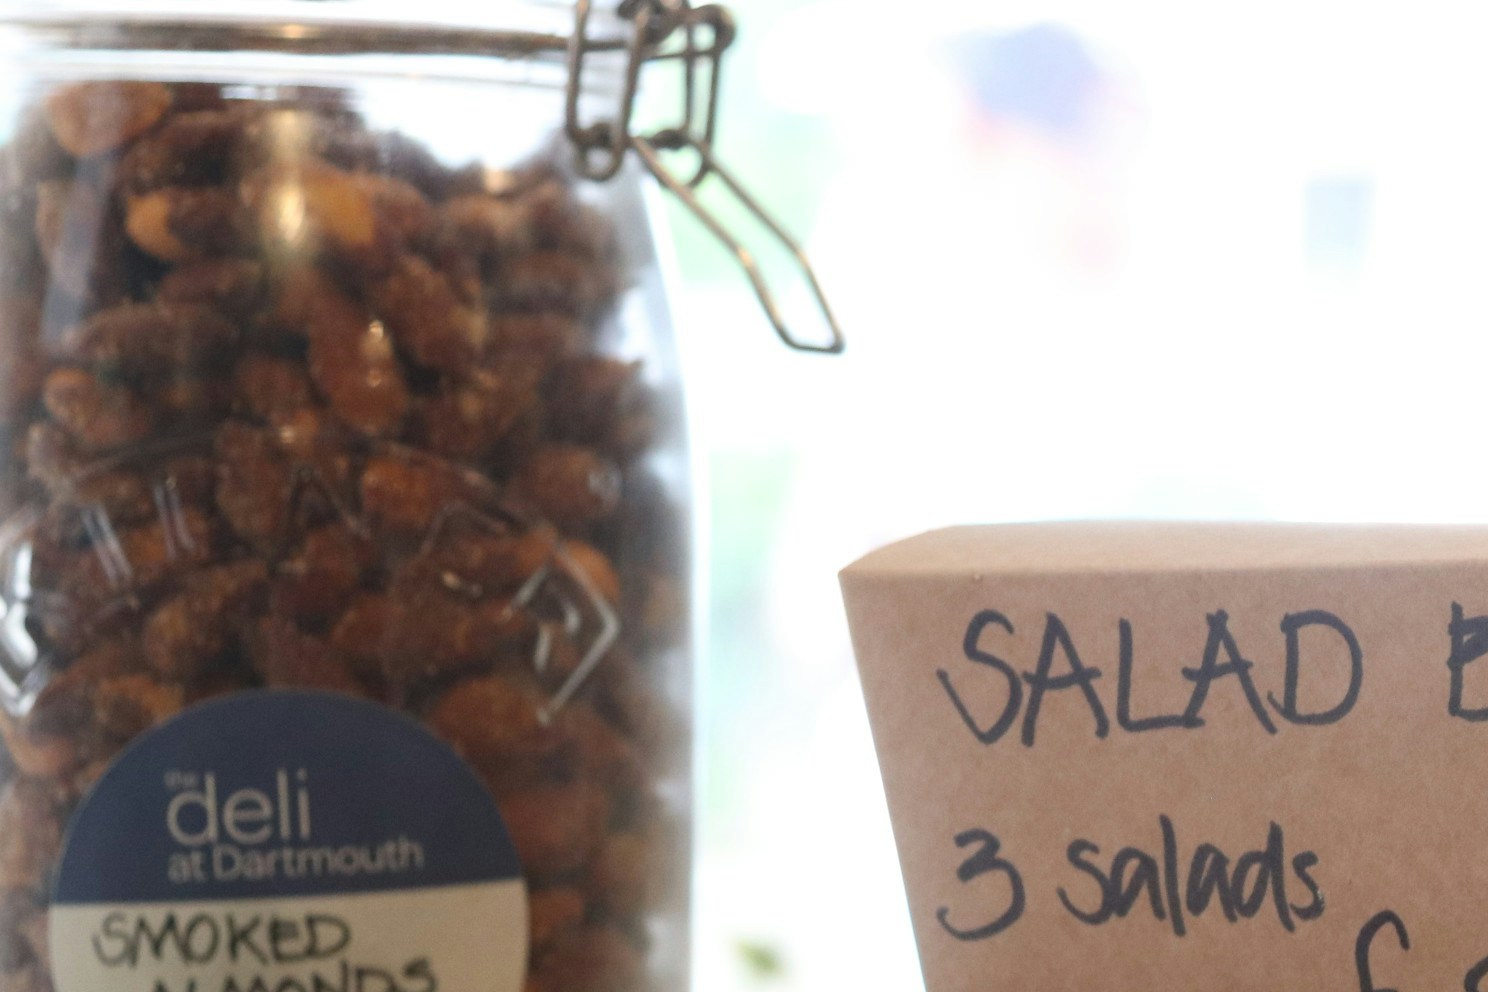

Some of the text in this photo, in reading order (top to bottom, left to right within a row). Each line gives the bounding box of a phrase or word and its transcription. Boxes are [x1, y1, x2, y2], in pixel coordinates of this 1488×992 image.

[936, 608, 1363, 747] SALAD
[167, 767, 312, 847] deli
[168, 836, 426, 883] at Dartmouth
[936, 813, 1326, 941] 3 salads
[92, 910, 352, 968] SMOKED
